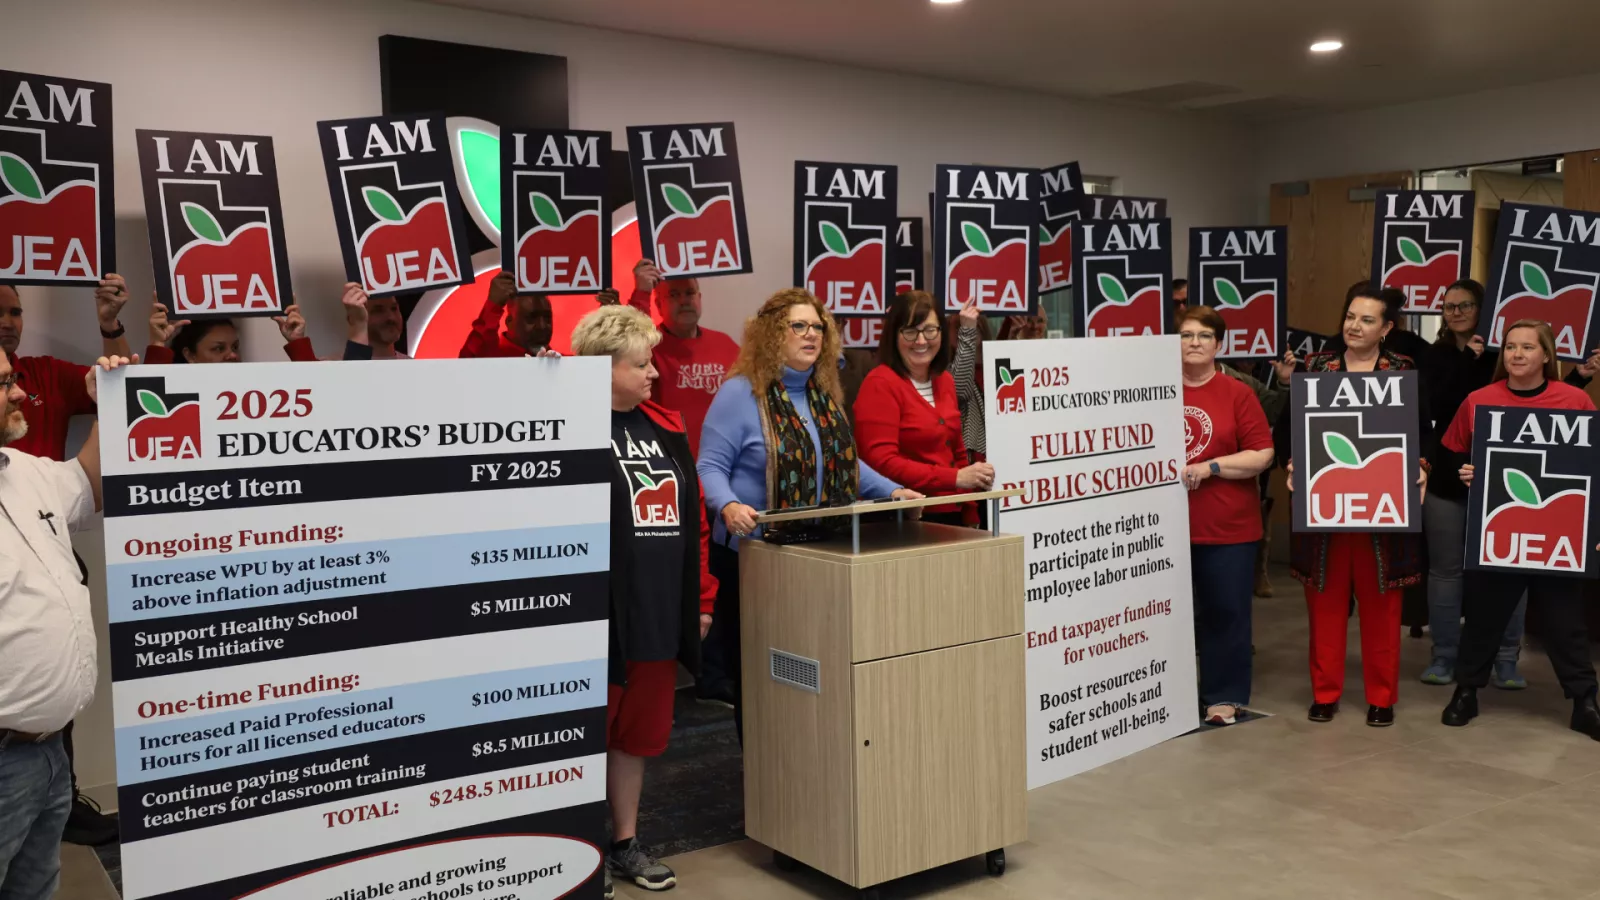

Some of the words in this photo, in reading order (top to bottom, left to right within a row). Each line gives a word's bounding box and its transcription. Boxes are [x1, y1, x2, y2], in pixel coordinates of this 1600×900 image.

[5, 80, 97, 127] AM
[152, 137, 174, 172] I
[184, 138, 262, 175] AM
[331, 125, 353, 161] I
[362, 118, 436, 158] AM
[512, 132, 528, 166] I
[535, 134, 600, 168] AM
[638, 131, 656, 161] I
[663, 127, 728, 158] AM
[804, 166, 819, 196] I
[825, 168, 886, 199] AM
[946, 169, 962, 198] I
[968, 171, 1029, 200] AM
[1040, 168, 1074, 197] M
[1108, 199, 1157, 220] AM
[1384, 194, 1398, 218] I
[1404, 194, 1463, 218] AM
[1082, 225, 1095, 252] I
[1103, 223, 1161, 251] AM
[1200, 231, 1212, 257] I
[1219, 230, 1276, 256] AM
[1509, 208, 1529, 237] I
[1533, 212, 1600, 246] AM
[363, 246, 456, 287] UEA
[519, 255, 599, 288] UEA
[658, 238, 739, 271] UEA
[176, 273, 276, 310] UEA
[949, 279, 1026, 310] UEA
[842, 318, 883, 347] UE
[1031, 367, 1069, 388] 2025
[1113, 385, 1176, 404] PRIORITIES
[1304, 378, 1320, 408] I
[1330, 376, 1404, 408] AM
[216, 389, 313, 420] 2025
[997, 398, 1026, 415] UEA
[1184, 406, 1211, 434] DUCATION
[437, 419, 566, 446] BUDGET
[1030, 429, 1096, 459] FULLY
[1102, 423, 1154, 449] FUND
[1486, 411, 1505, 442] I
[1512, 413, 1593, 446] AM
[129, 435, 200, 460] UEA
[627, 438, 664, 458] AM
[471, 463, 502, 483] FY
[507, 460, 561, 480] 2025
[1001, 473, 1087, 508] PUBLIC
[1092, 459, 1177, 494] SCHOOLS
[128, 481, 233, 507] Budget
[238, 477, 302, 498] Item
[1311, 493, 1403, 524] UEA
[635, 504, 678, 523] UEA
[1032, 525, 1087, 549] Protect
[1091, 521, 1112, 538] the
[1115, 513, 1145, 534] right
[1148, 512, 1159, 525] to
[124, 533, 233, 558] Ongoing
[238, 524, 344, 548] Funding:
[470, 549, 509, 566] $135
[513, 542, 589, 562] MILLION
[1029, 547, 1109, 580] participate
[1112, 542, 1124, 558] in
[1127, 533, 1164, 558] public
[1486, 531, 1579, 569] UEA
[131, 568, 217, 588] Increase
[220, 561, 267, 579] WPU
[272, 560, 294, 576] by
[297, 558, 315, 571] at
[319, 552, 362, 568] least
[365, 550, 390, 564] 3%
[1024, 575, 1091, 603] mployee
[1094, 568, 1128, 587] labor
[1131, 557, 1174, 578] unions.
[132, 592, 191, 611] above
[196, 583, 279, 604] inflation
[283, 571, 387, 595] adjustment
[470, 601, 491, 616] $5
[495, 593, 572, 614] MILLION
[134, 624, 216, 648] Support
[220, 615, 295, 636] Healthy
[297, 606, 358, 627] School
[1027, 627, 1057, 649] End
[1062, 612, 1121, 641] taxpayer
[1124, 598, 1172, 624] funding
[135, 648, 193, 668] Meals
[197, 637, 285, 660] Initiative
[1063, 646, 1085, 665] for
[1088, 630, 1149, 657] vouchers.
[137, 689, 252, 719] One-time
[257, 673, 360, 701] Funding:
[471, 689, 513, 708] $100
[516, 678, 592, 700] MILLION
[1040, 685, 1083, 711] Boost
[1086, 666, 1148, 698] resources
[1149, 659, 1167, 677] for
[139, 723, 236, 751] Increased
[239, 714, 281, 741] Paid
[285, 697, 394, 728] Professional
[1048, 711, 1085, 734] safer
[1088, 692, 1137, 722] schools
[1139, 681, 1162, 703] and
[140, 751, 201, 771] Hours
[204, 744, 233, 761] for
[236, 738, 260, 755] all
[264, 726, 338, 749] licensed
[341, 713, 426, 737] educators
[472, 738, 507, 758] $8.5
[511, 727, 586, 751] MILLION
[1041, 729, 1098, 762] student
[1101, 705, 1170, 742] well-being.
[141, 781, 233, 808] Continue
[236, 767, 300, 792] paying
[302, 754, 370, 777] student
[143, 803, 228, 829] teachers
[230, 795, 259, 813] for
[261, 777, 353, 806] classroom
[355, 762, 426, 787] training
[322, 800, 400, 829] TOTAL:
[429, 781, 493, 809] $248.5
[498, 765, 585, 794] MILLION
[325, 882, 394, 900] liable
[398, 871, 432, 892] and
[436, 857, 507, 886] growing
[477, 880, 494, 892] to
[498, 862, 563, 887] support
